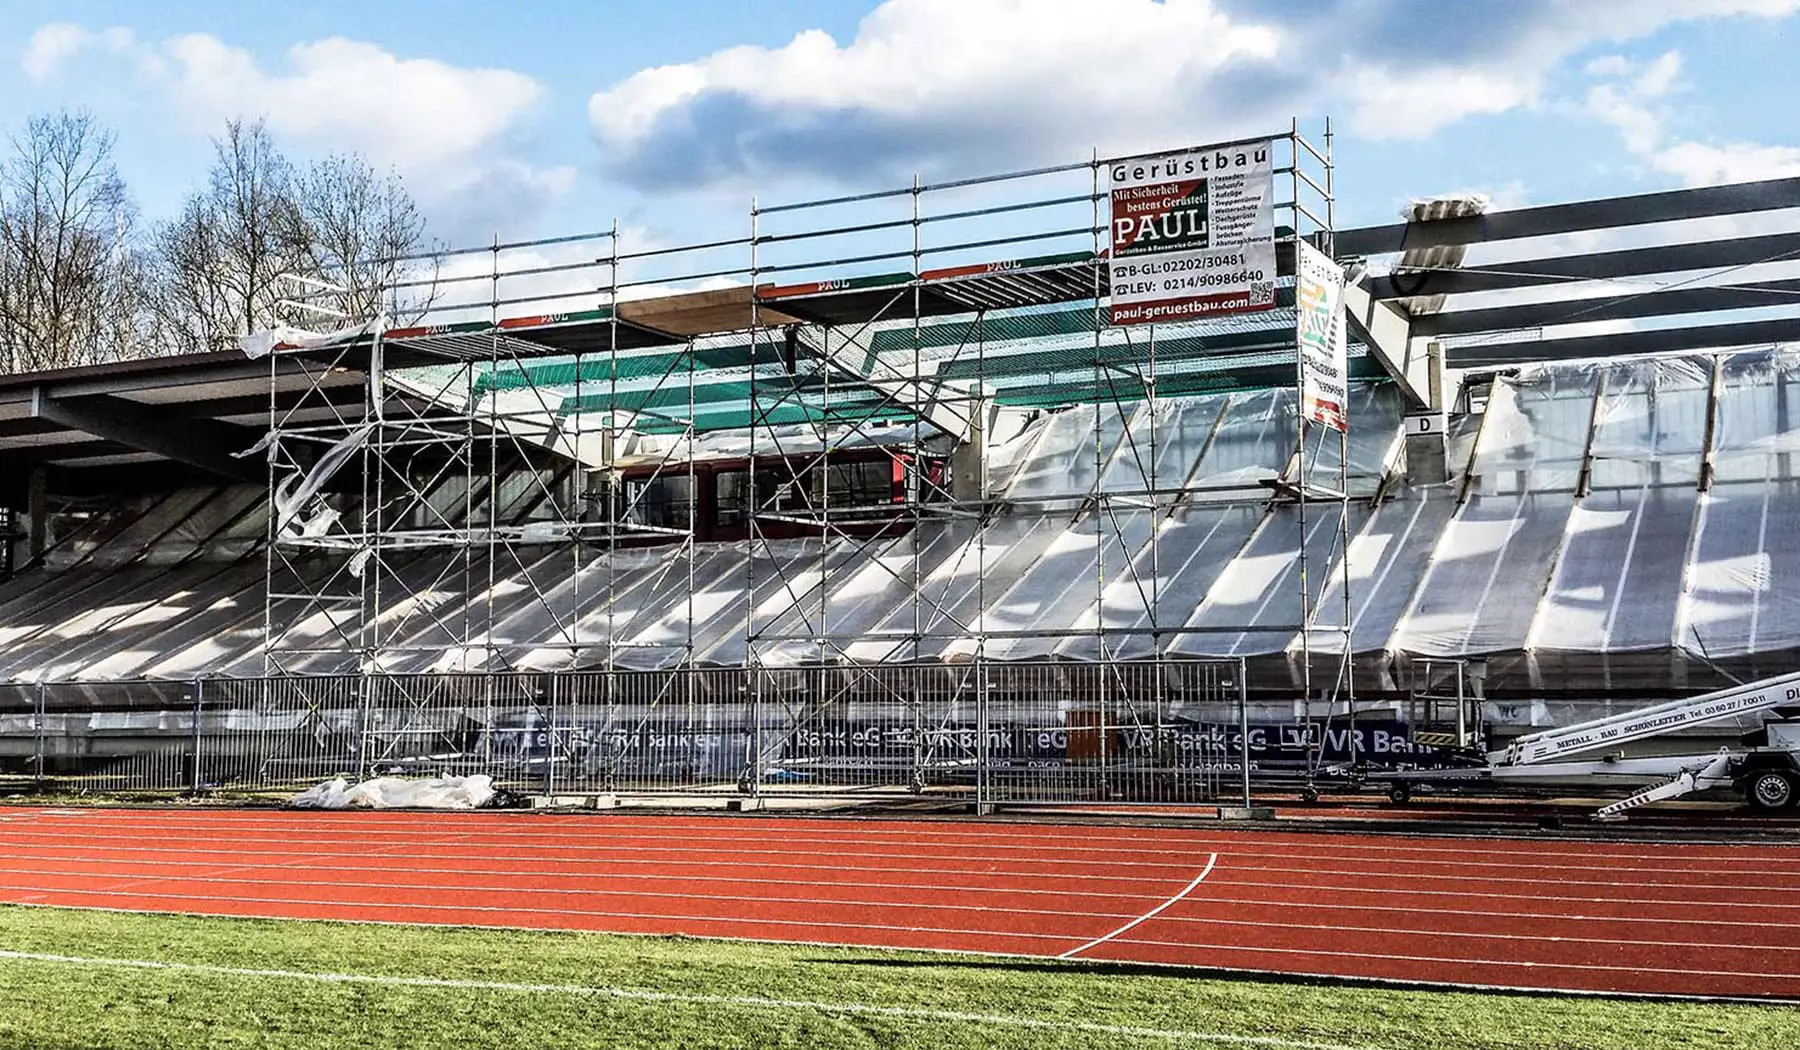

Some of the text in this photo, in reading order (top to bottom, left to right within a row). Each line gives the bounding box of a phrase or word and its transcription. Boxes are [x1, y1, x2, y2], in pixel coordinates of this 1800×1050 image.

[1112, 149, 1267, 182] Gerüstbau
[1114, 184, 1179, 201] Mit Sicherheit
[1214, 181, 1244, 190] Industrie
[1215, 190, 1243, 199] Aufzüge
[1127, 193, 1207, 213] bestens Gerüstet!
[1114, 209, 1207, 244] PAUL
[987, 259, 1021, 272] PAUL
[817, 279, 850, 291] PAUL
[1130, 270, 1264, 294] LEV: 0214/90986640
[1114, 298, 1249, 322] paul-geruestbau.com
[1419, 417, 1431, 432] D
[1327, 730, 1366, 753] VR
[1556, 735, 1592, 749] METALL
[1600, 728, 1618, 739] BAU
